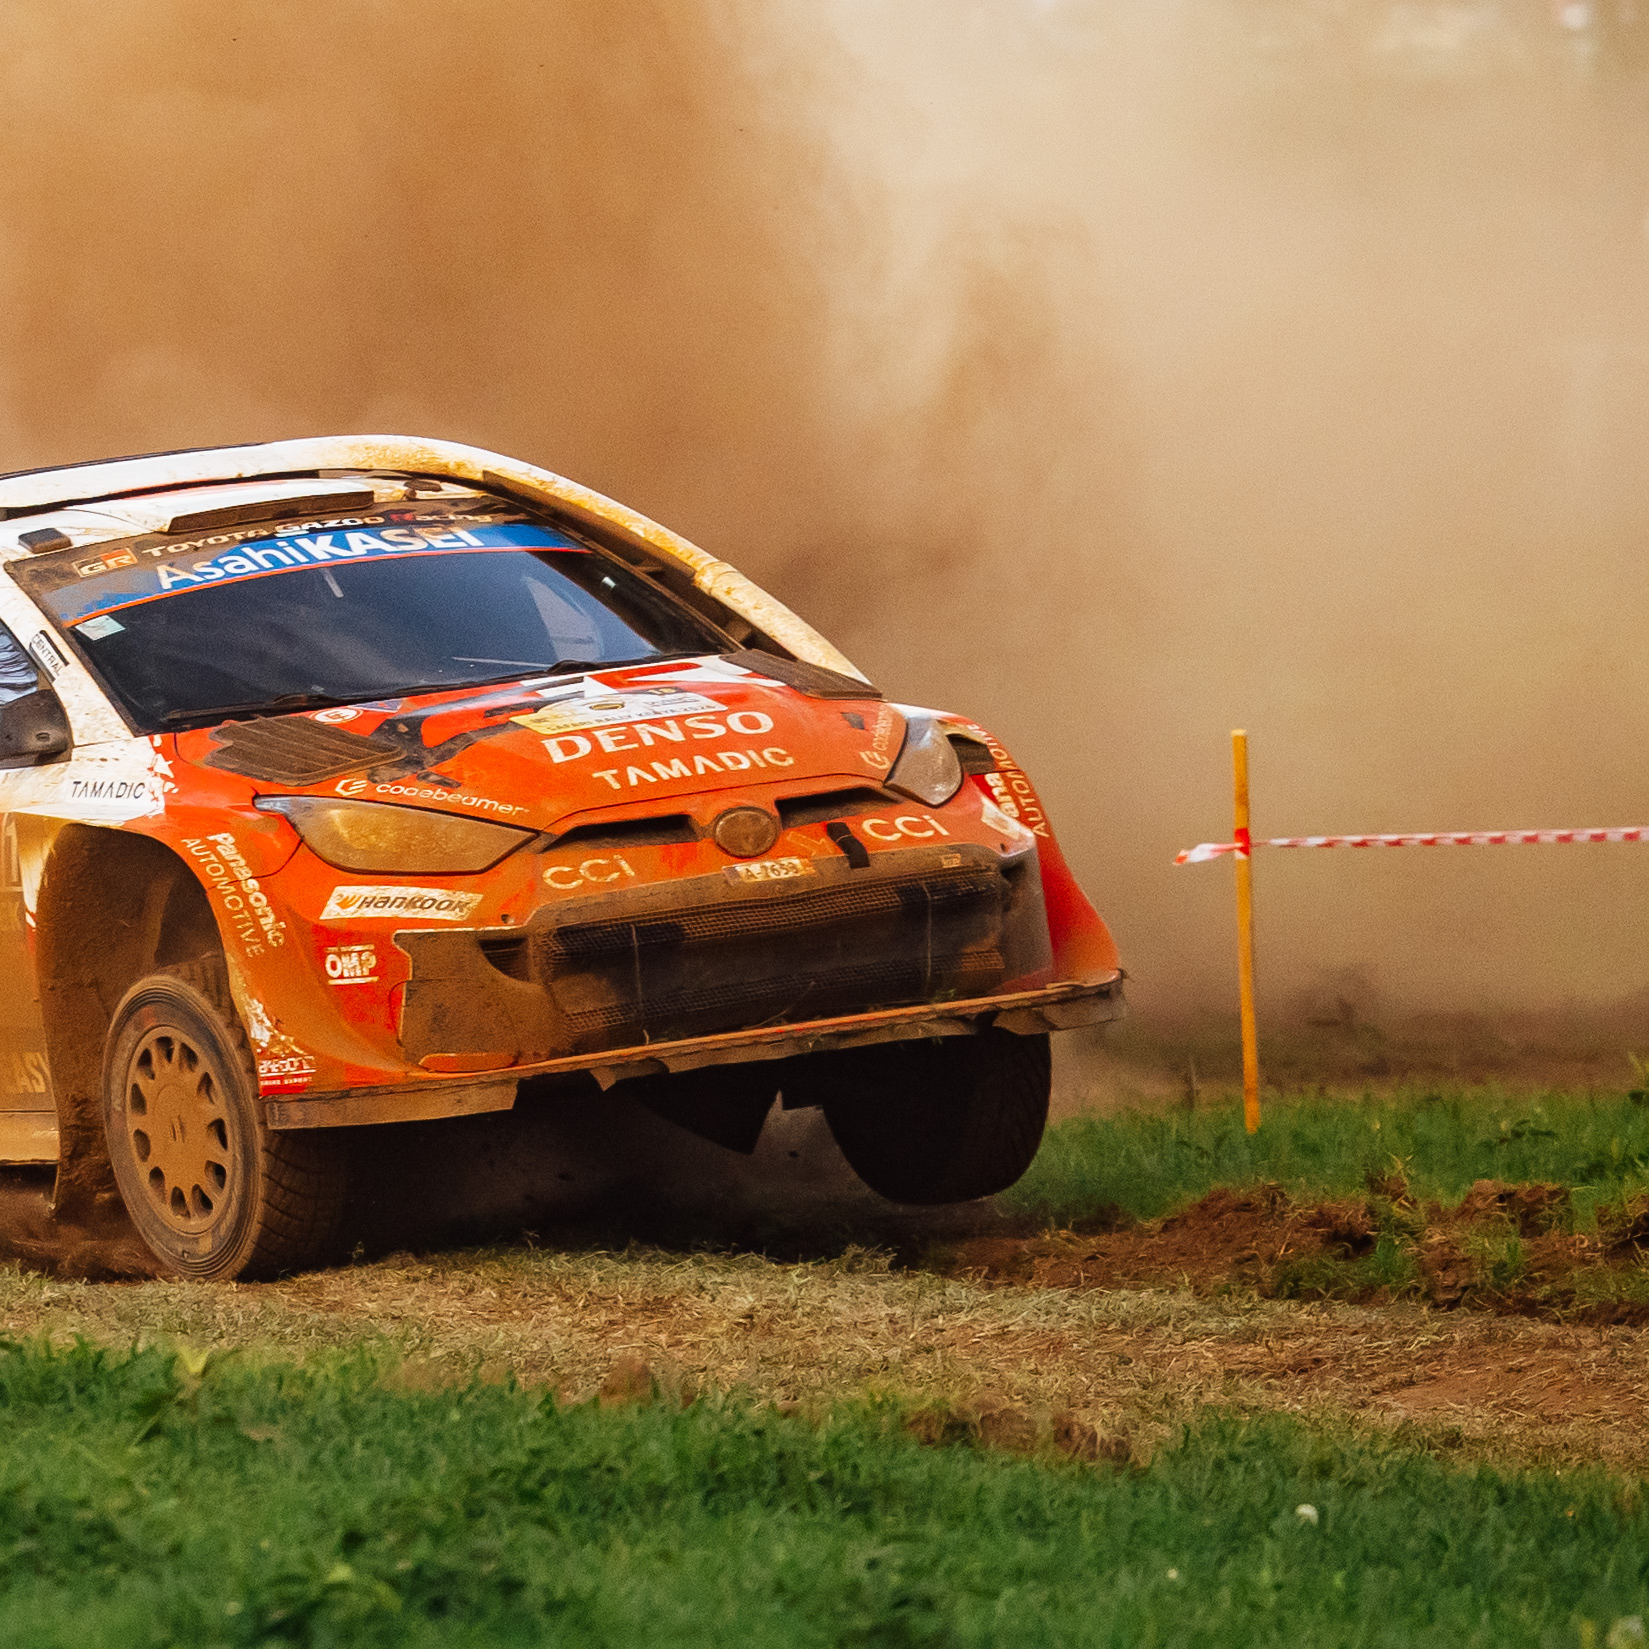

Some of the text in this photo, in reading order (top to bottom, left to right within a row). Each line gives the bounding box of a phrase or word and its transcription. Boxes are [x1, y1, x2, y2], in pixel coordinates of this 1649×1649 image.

[142, 529, 268, 558] TOYOTA
[275, 515, 385, 536] GAZOO
[78, 553, 135, 575] GR
[32, 633, 61, 678] CENTRAL
[541, 711, 775, 764] DENSO
[595, 713, 633, 726] RALLY
[71, 780, 146, 800] TAMADIC
[592, 747, 795, 790] TAMADIC
[968, 723, 1050, 838] AUTOMOTIVE
[181, 838, 265, 958] AUTOMOTIVE
[206, 832, 287, 947] Panasonic
[325, 951, 377, 978] OMP
